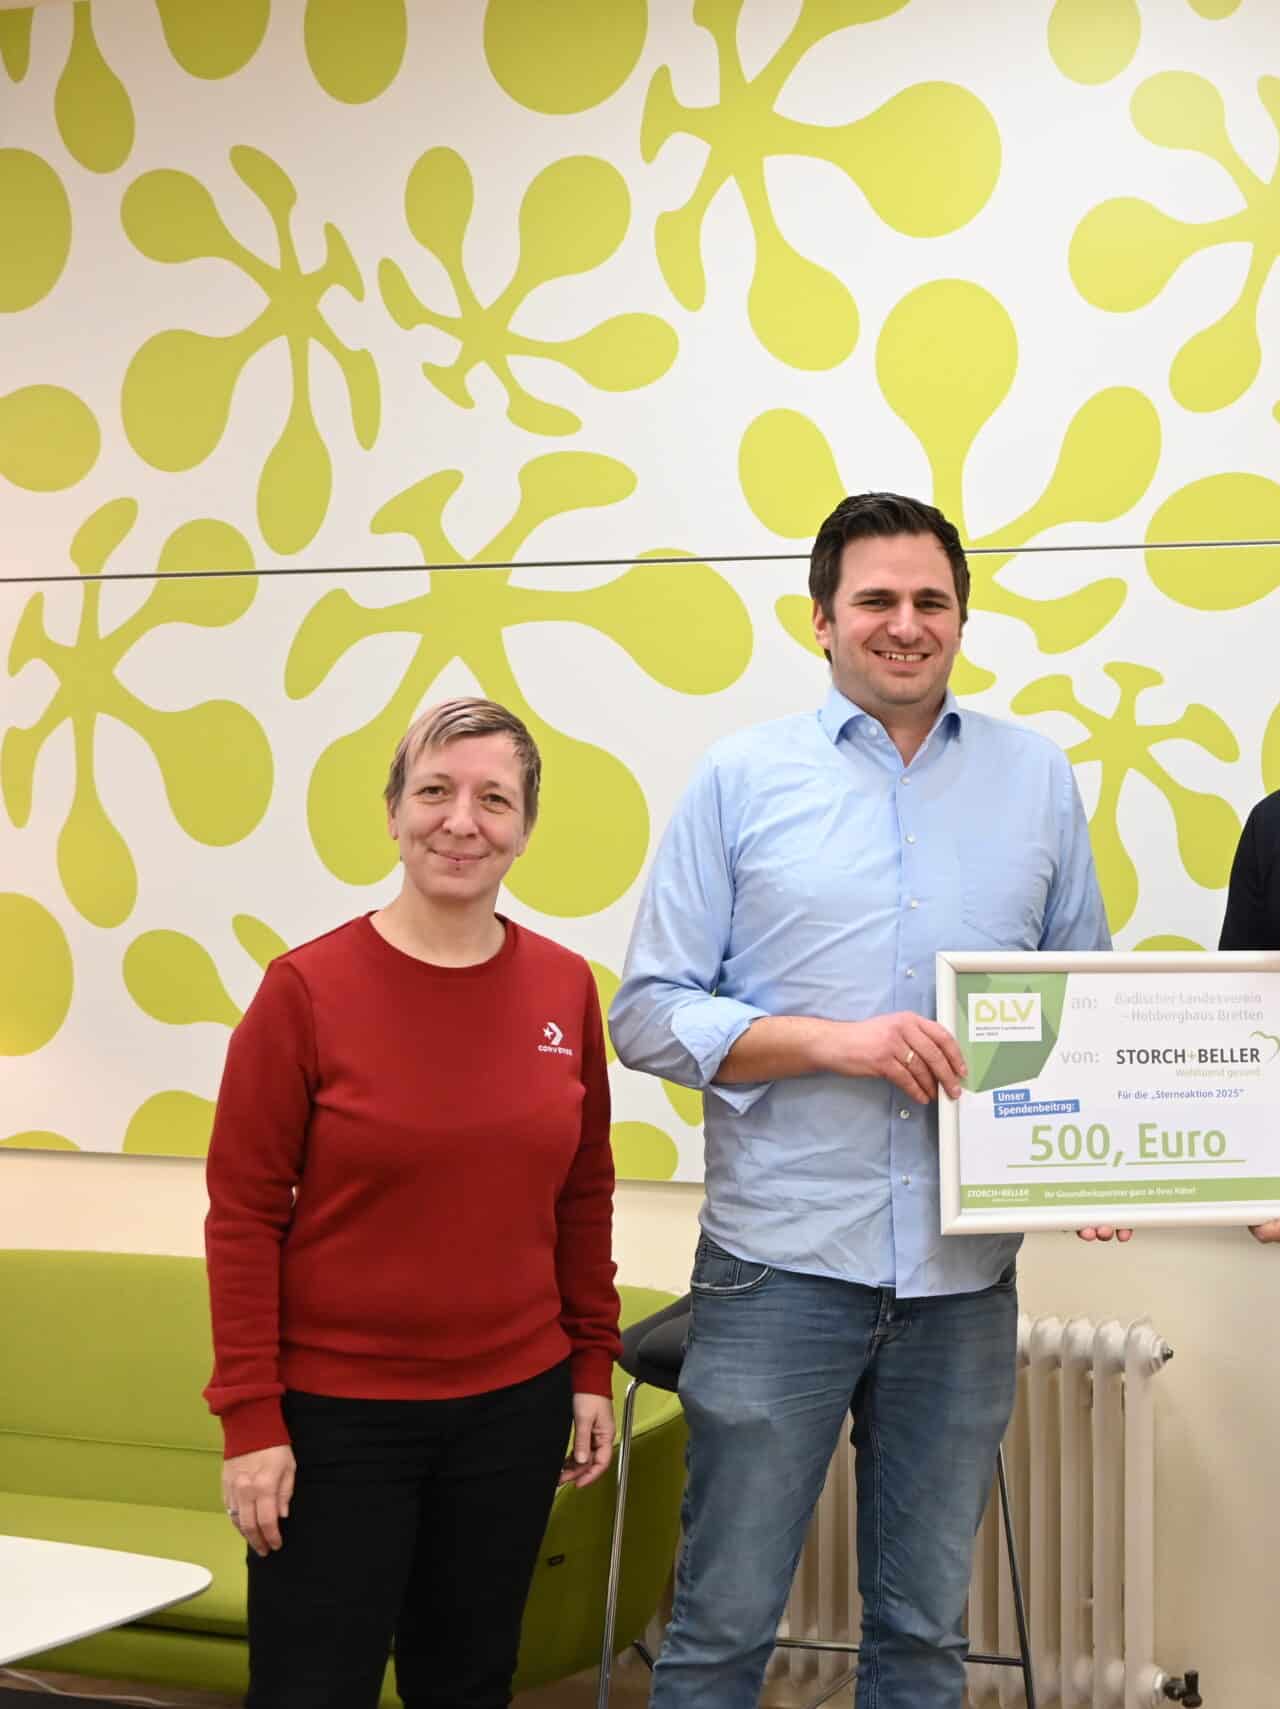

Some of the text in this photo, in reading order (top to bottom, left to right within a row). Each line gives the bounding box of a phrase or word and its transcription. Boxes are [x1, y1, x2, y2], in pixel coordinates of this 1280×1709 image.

[1071, 997, 1097, 1009] an:
[975, 999, 1035, 1022] BLV
[1217, 1008, 1264, 1021] Bretten
[1060, 1051, 1100, 1064] von:
[998, 1092, 1025, 1101] Unser
[1117, 1090, 1132, 1100] Für
[1134, 1090, 1148, 1099] die
[1029, 1123, 1227, 1167] 500, Euro
